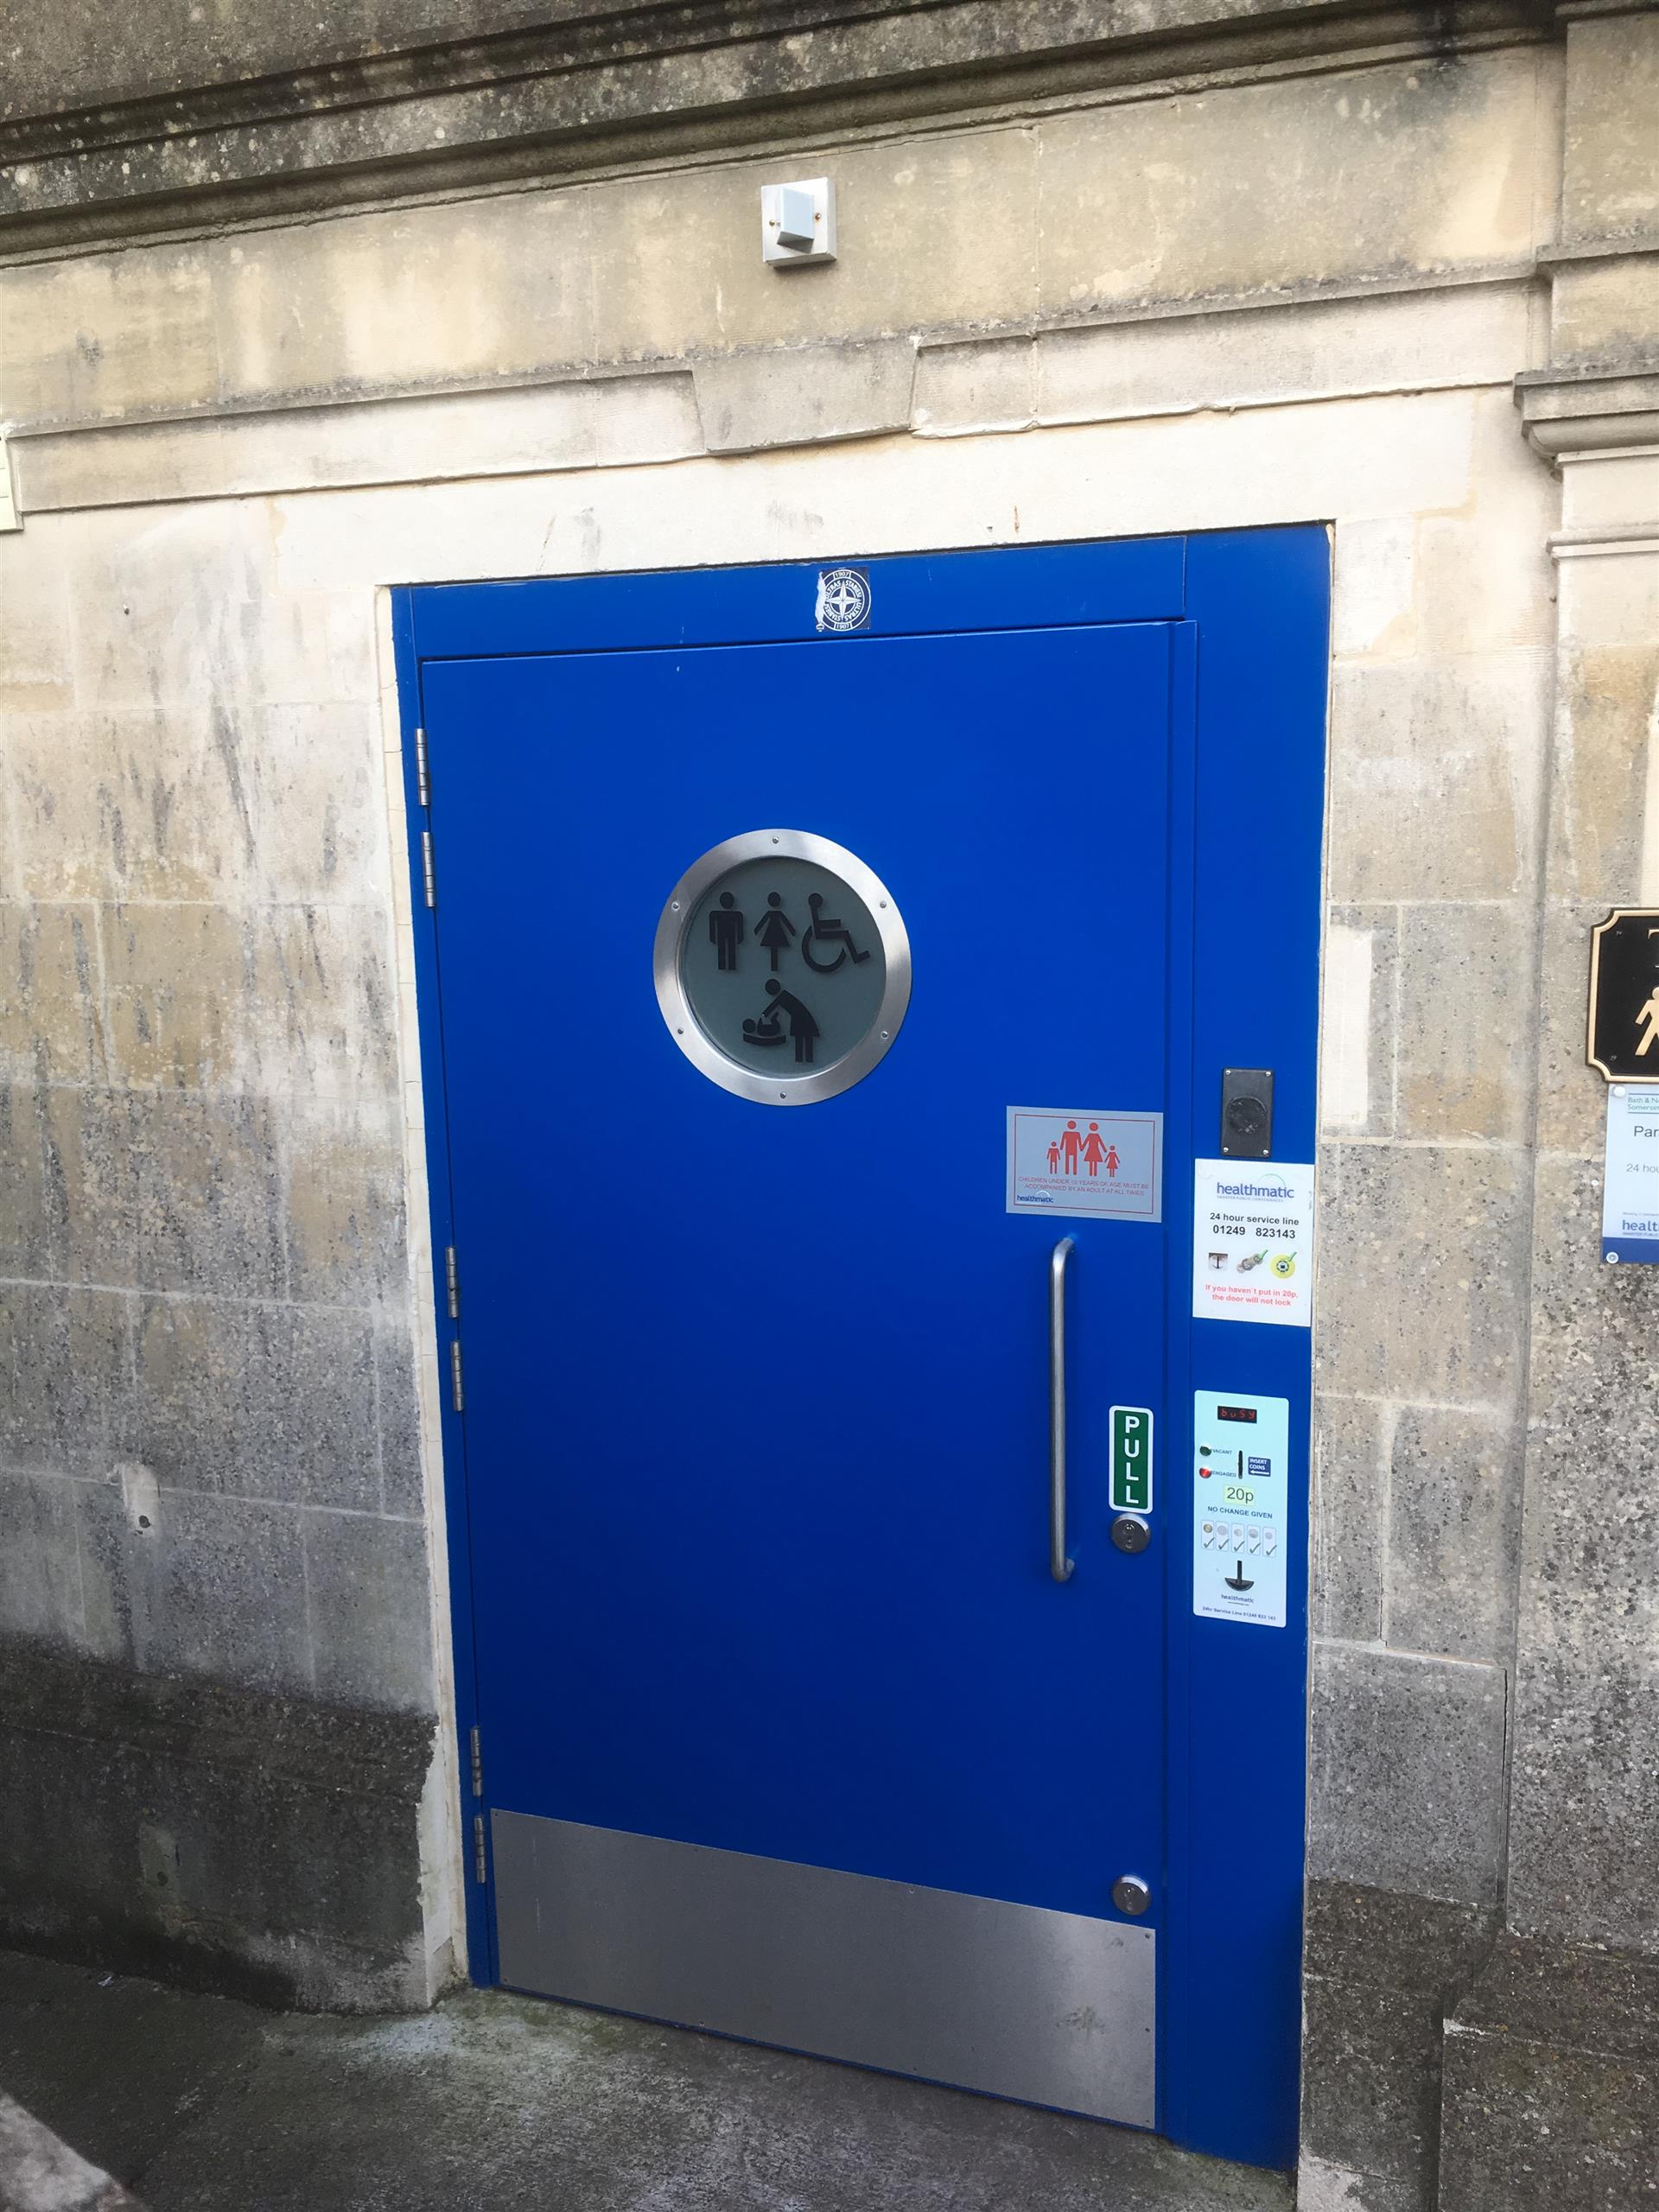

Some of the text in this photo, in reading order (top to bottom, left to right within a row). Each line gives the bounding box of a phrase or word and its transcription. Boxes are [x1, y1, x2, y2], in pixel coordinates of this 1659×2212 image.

[1634, 1125, 1659, 1137] Par
[1626, 1163, 1639, 1173] 24
[1217, 1182, 1294, 1198] healthmatic
[1017, 1194, 1053, 1203] healthmatic
[1223, 1213, 1244, 1222] hour
[1247, 1216, 1280, 1224] service
[1282, 1217, 1299, 1225] line
[1212, 1224, 1296, 1239] 01249 823143
[1622, 1219, 1659, 1232] healt
[1124, 1415, 1140, 1503] PULL
[1227, 1487, 1254, 1503] 20p
[1219, 1507, 1249, 1516] CHANGE
[1221, 1594, 1255, 1603] healthmatic
